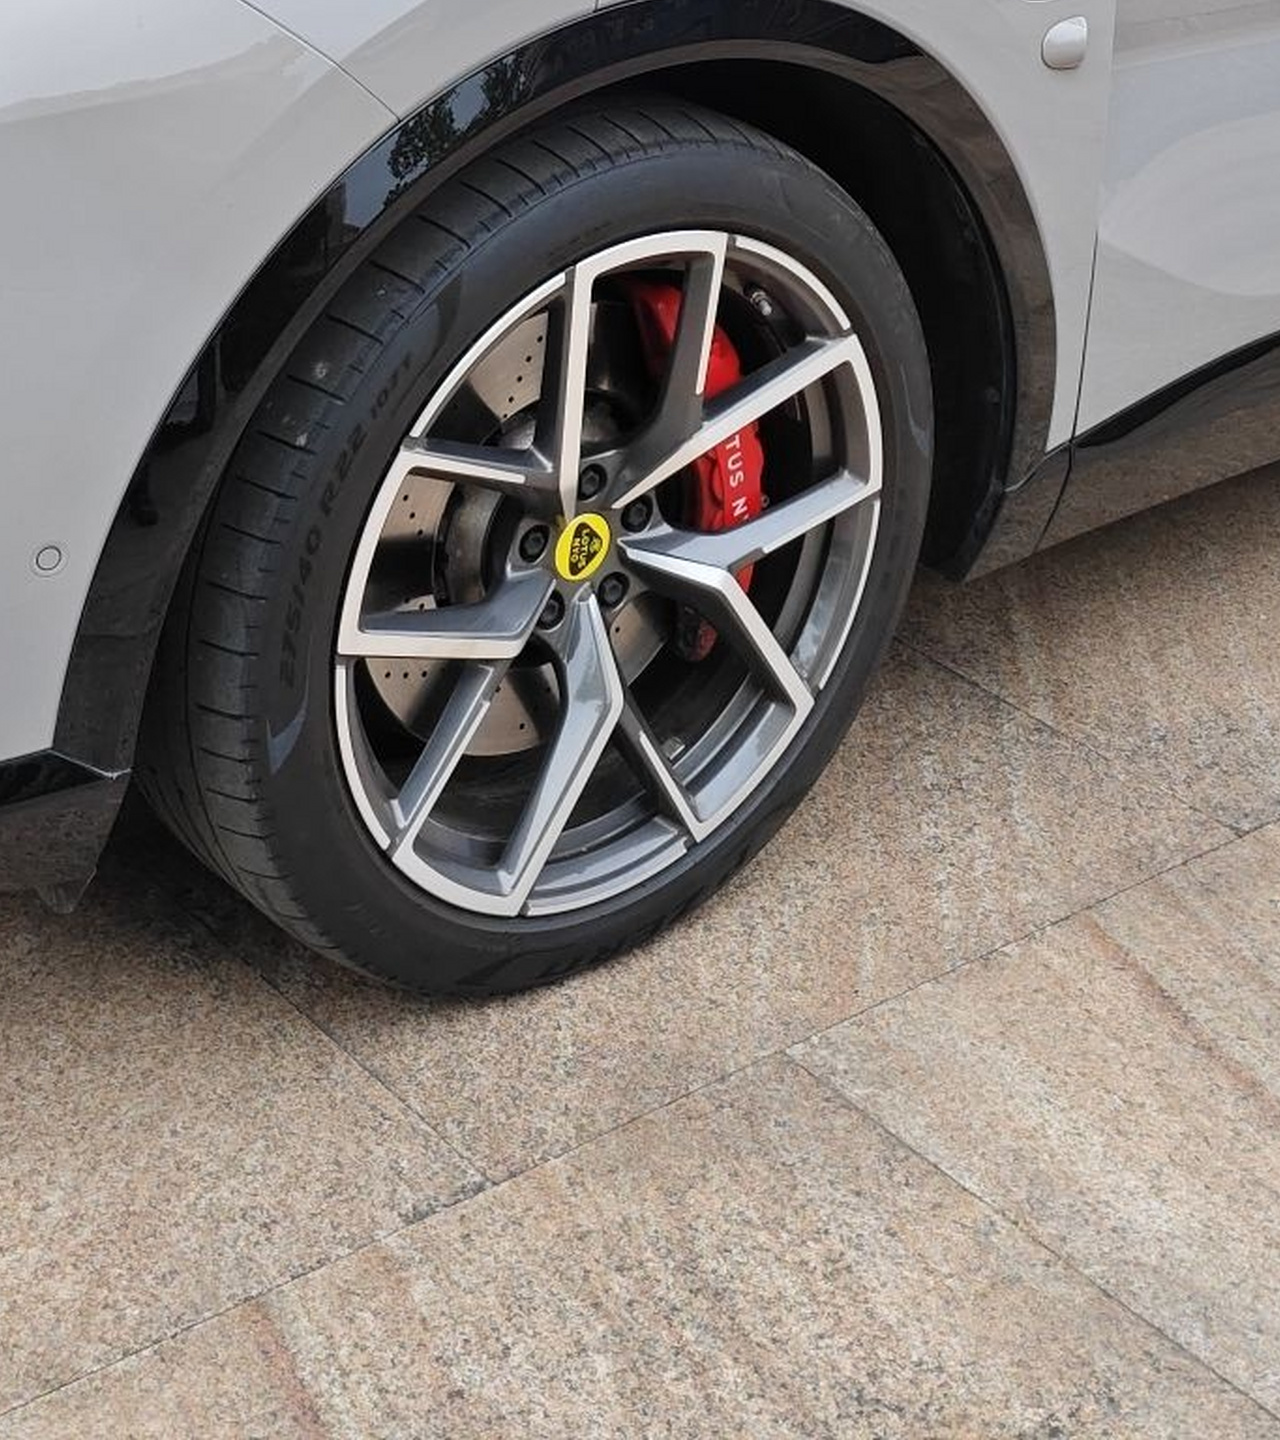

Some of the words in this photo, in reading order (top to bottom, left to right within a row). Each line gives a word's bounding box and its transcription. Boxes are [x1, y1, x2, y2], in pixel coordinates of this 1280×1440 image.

[321, 422, 368, 517] R22
[725, 433, 744, 488] TUS
[577, 528, 591, 569] LOTUS
